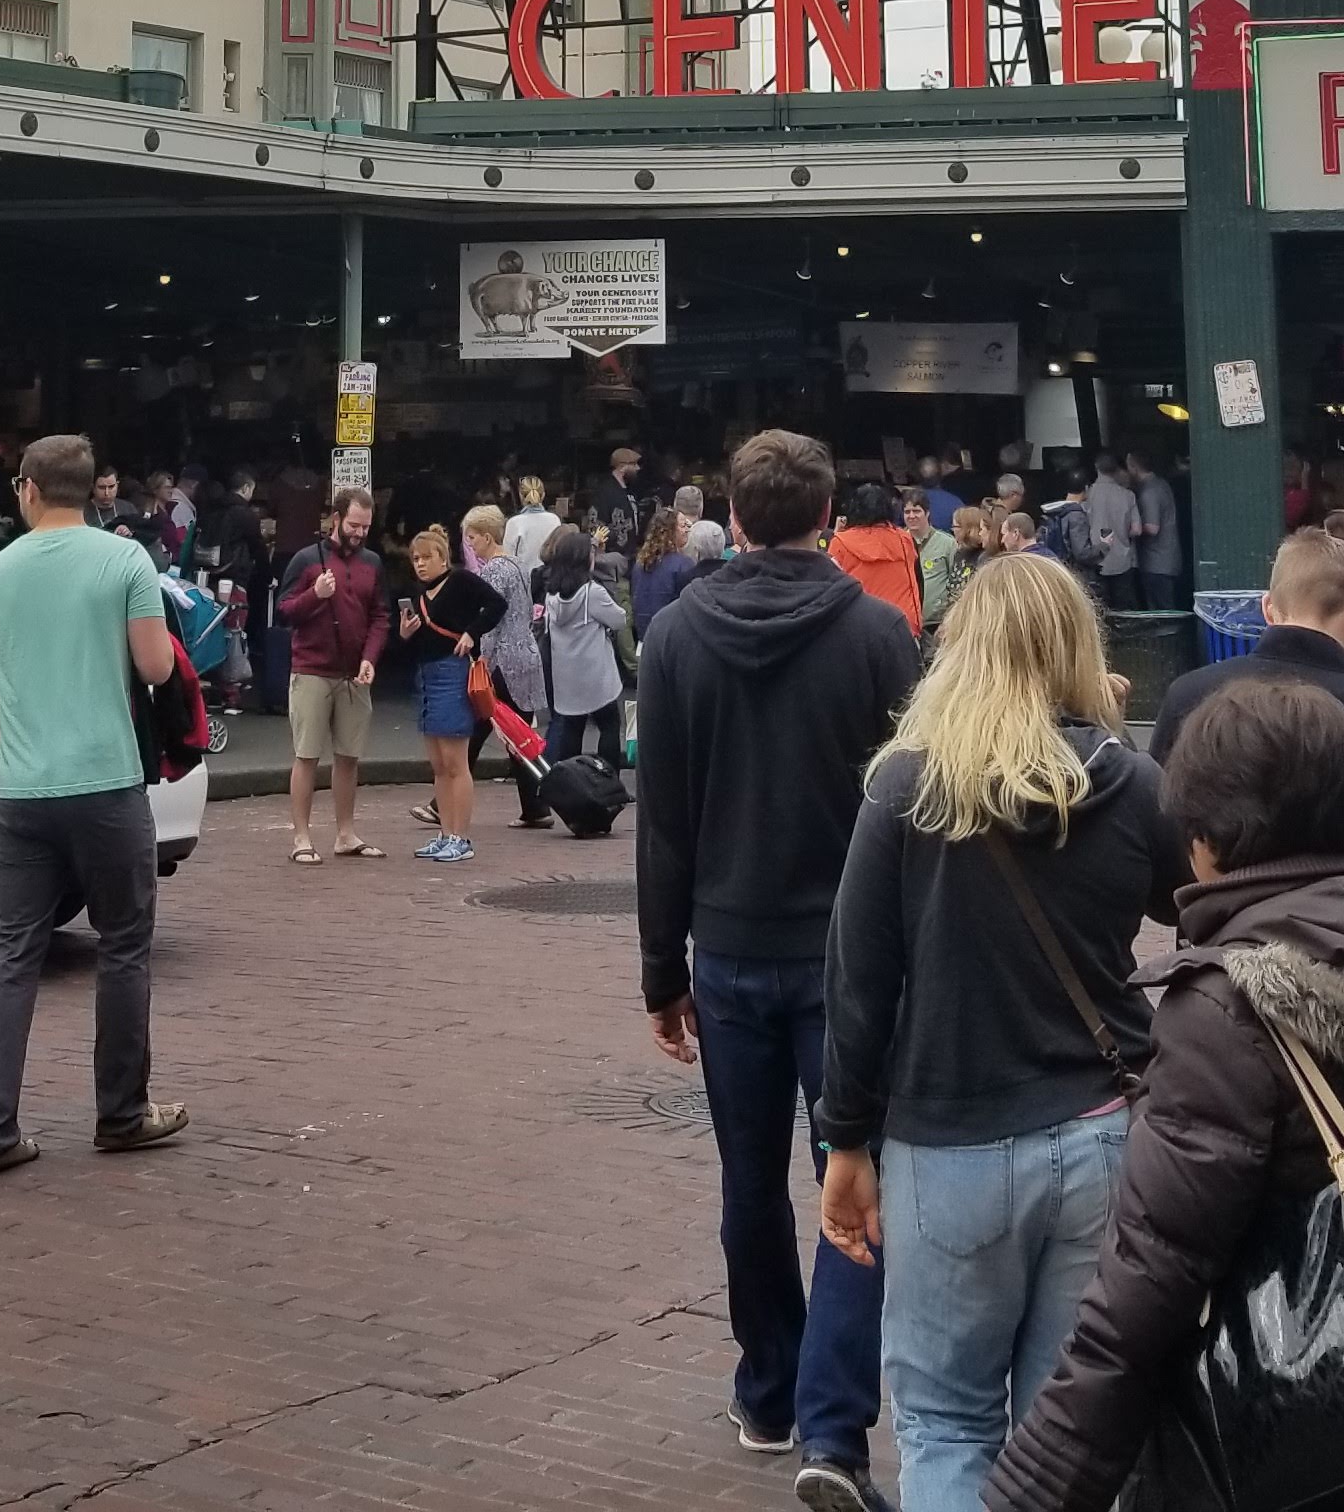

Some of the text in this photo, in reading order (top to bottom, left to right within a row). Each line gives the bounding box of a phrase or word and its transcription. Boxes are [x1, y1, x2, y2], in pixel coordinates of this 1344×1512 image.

[541, 250, 660, 274] YOUR CHANGE
[561, 273, 660, 284] CHANGES LIVES!
[601, 289, 659, 297] GENEROSITY
[603, 306, 659, 314] FOUNDATION
[563, 328, 640, 337] DONATE HERE!
